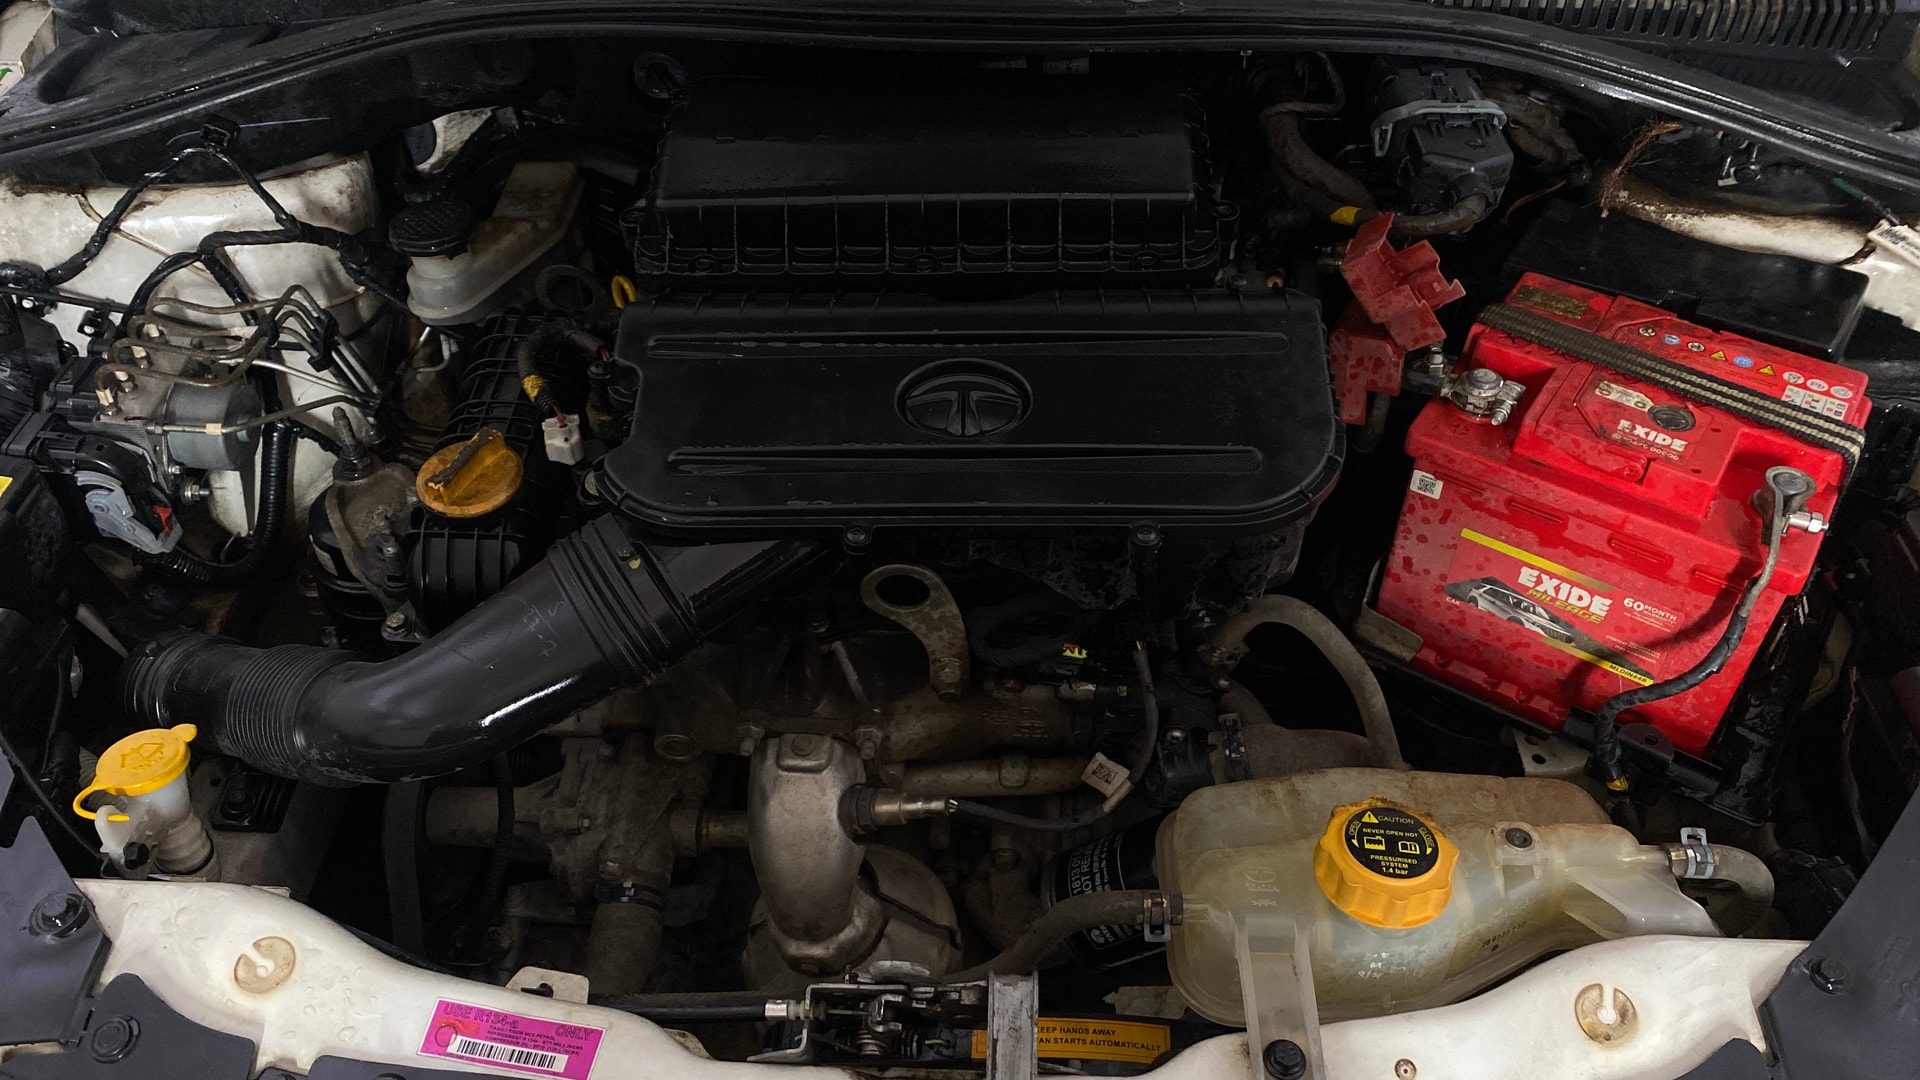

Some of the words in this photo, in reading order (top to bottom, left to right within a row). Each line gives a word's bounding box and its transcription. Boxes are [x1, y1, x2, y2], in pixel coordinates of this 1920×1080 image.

[1617, 419, 1688, 452] EXIDE
[1517, 566, 1613, 617] EXIDE
[1446, 596, 1461, 606] CAR
[1526, 588, 1605, 624] MILEAGE
[1623, 597, 1644, 612] 60
[1644, 604, 1677, 621] MONTH
[1377, 815, 1414, 825] CAUTION
[1348, 820, 1360, 836] OPEN
[1362, 827, 1385, 835] NEVER
[1386, 829, 1404, 837] OPEN
[1420, 826, 1436, 848] CLOSE
[1370, 854, 1418, 865] PRESSURISED
[1381, 861, 1409, 869] SYSTEM
[1395, 867, 1409, 875] bar
[443, 1003, 473, 1020] USE
[555, 1024, 594, 1041] ONLY
[1060, 1027, 1090, 1035] HANDS
[1092, 1028, 1117, 1036] AWAY
[1053, 1037, 1087, 1046] STARTS
[1089, 1039, 1162, 1051] AUTOMATICALLY
